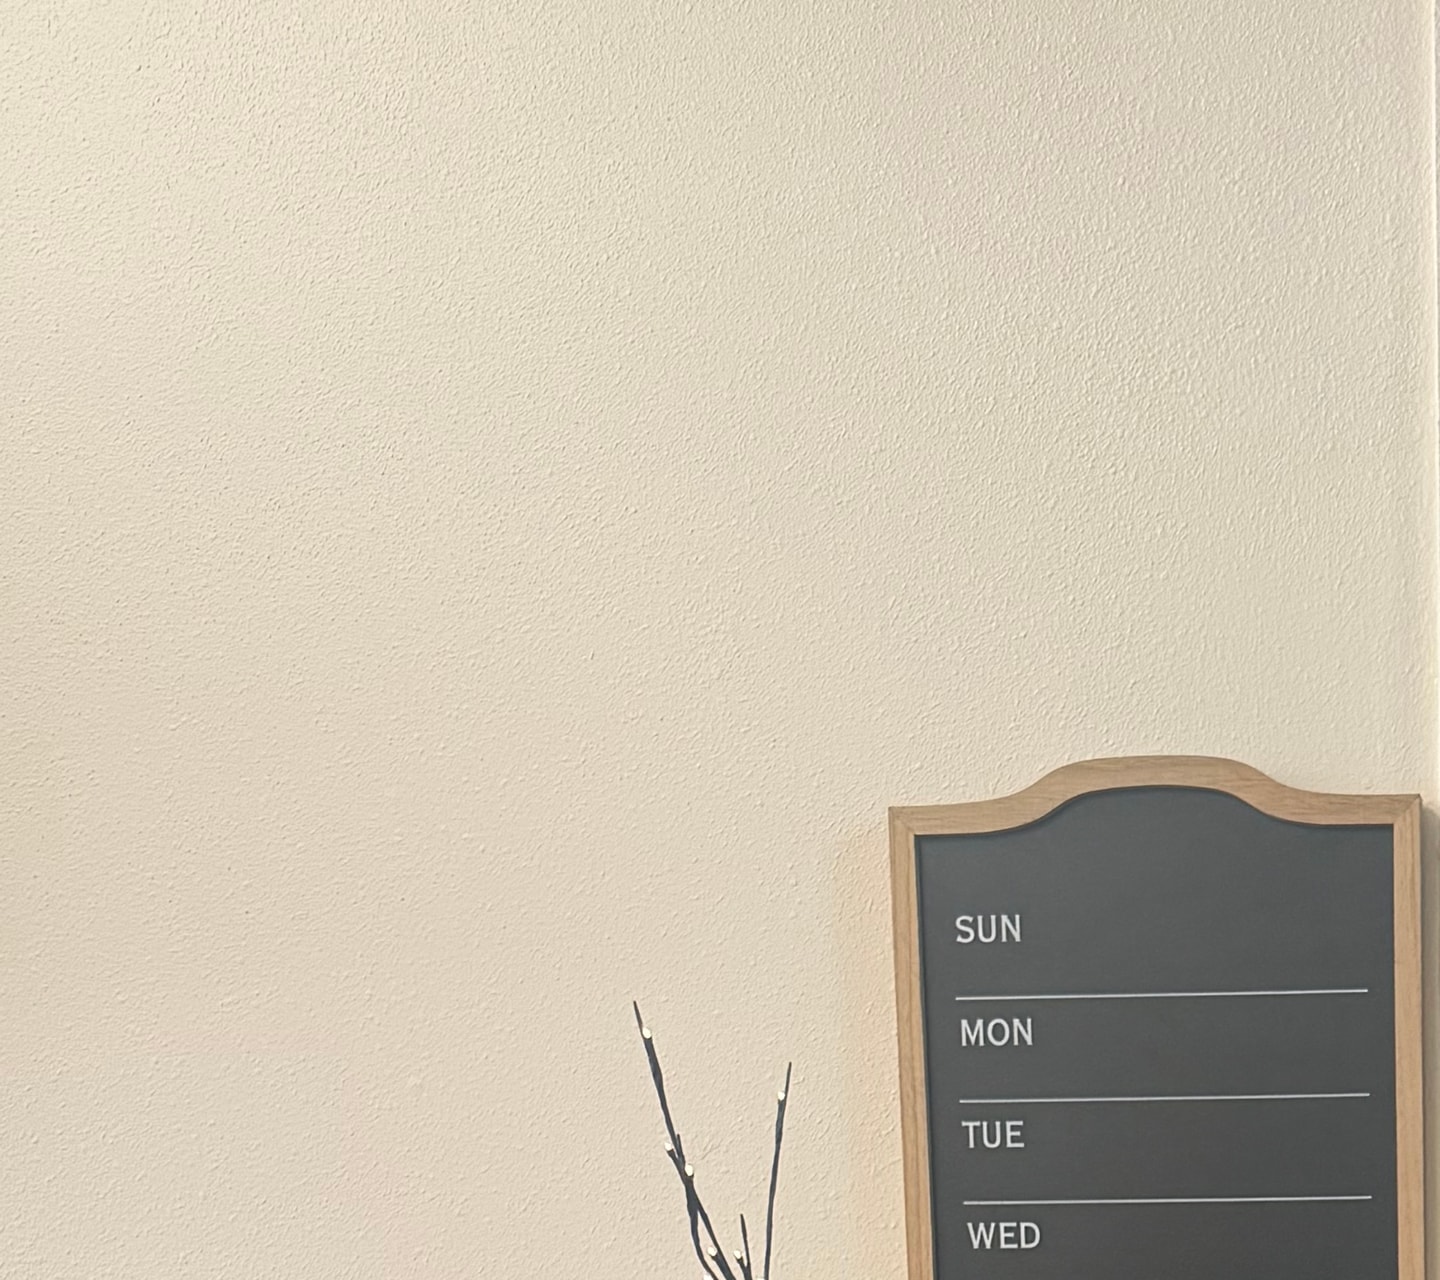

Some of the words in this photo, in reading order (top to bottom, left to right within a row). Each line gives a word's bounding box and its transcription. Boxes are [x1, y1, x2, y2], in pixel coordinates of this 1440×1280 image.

[955, 914, 1021, 943] SUN
[961, 1018, 1033, 1046] MON
[961, 1120, 1025, 1149] TUE
[967, 1222, 1041, 1249] WED
